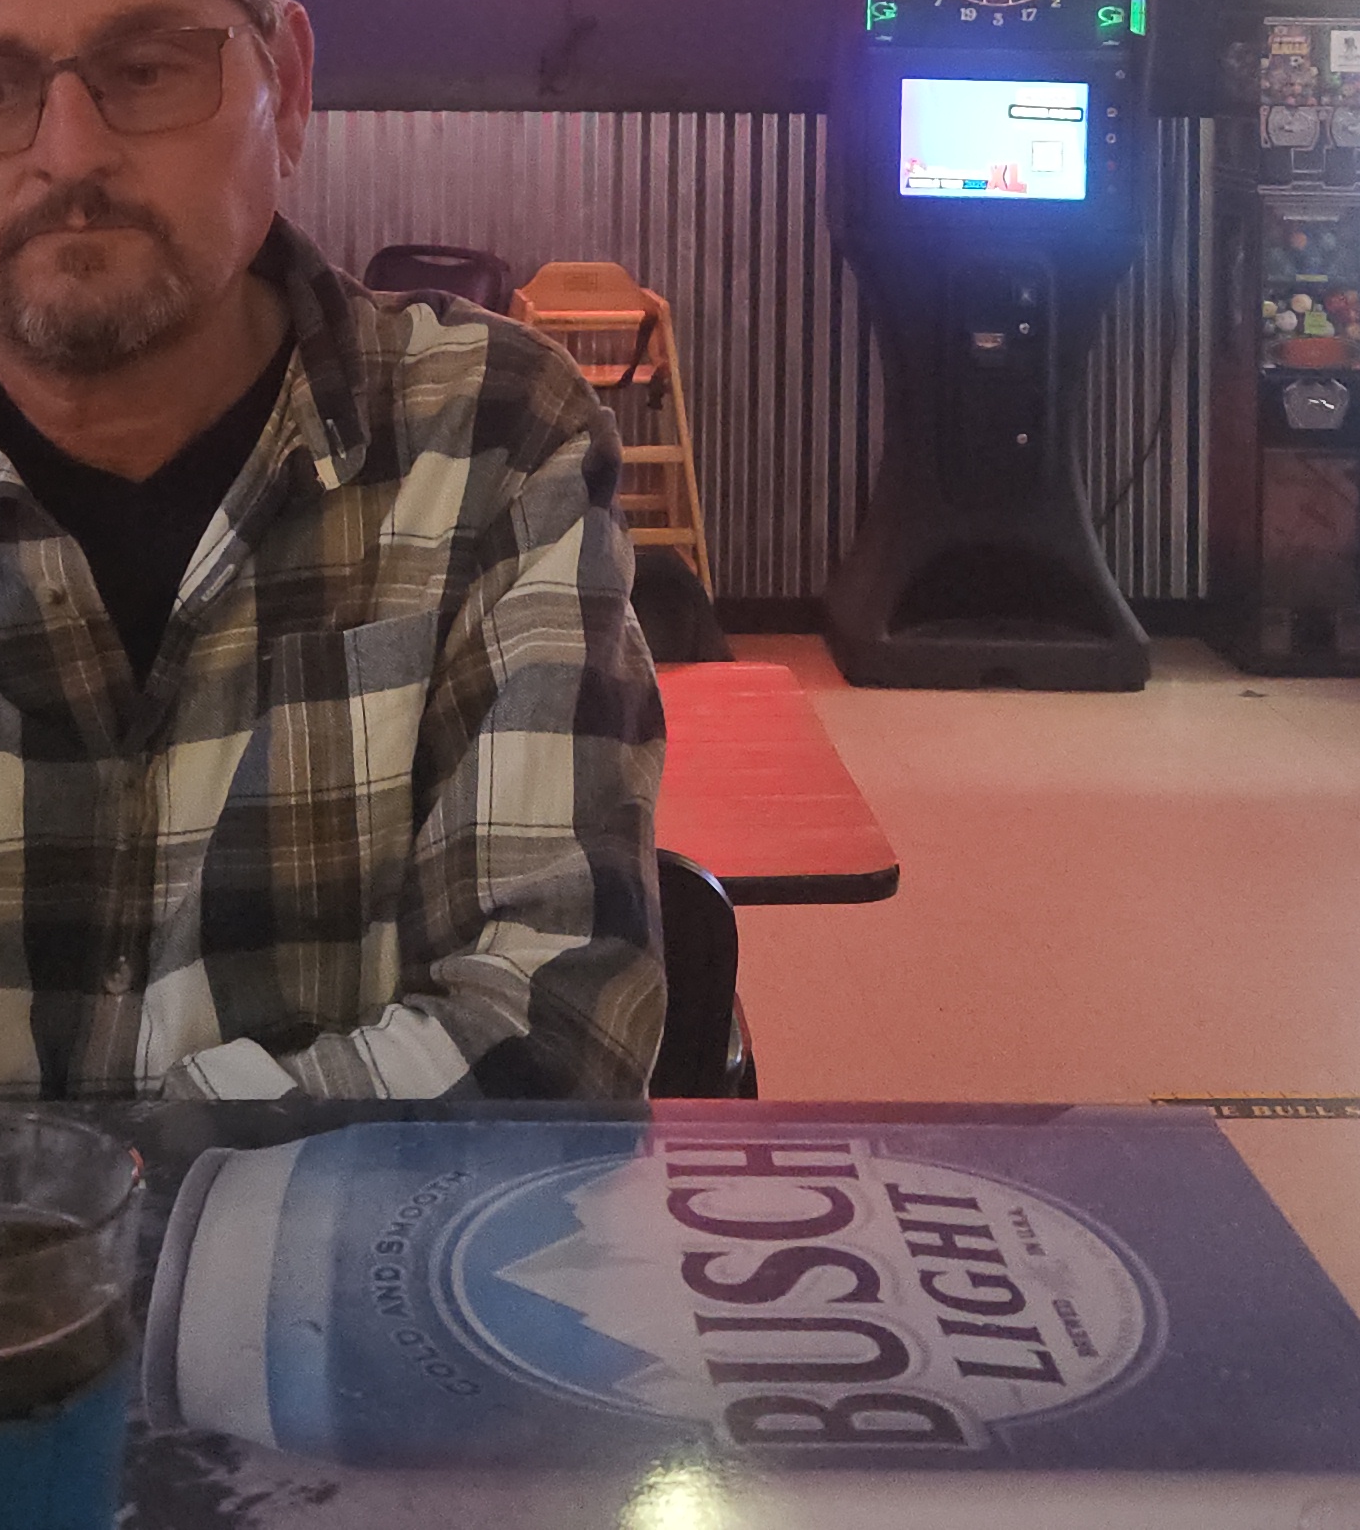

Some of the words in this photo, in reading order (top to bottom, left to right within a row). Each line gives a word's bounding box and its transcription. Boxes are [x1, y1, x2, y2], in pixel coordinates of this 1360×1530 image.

[960, 7, 977, 21] 19
[992, 12, 1004, 26] 3
[1020, 8, 1037, 22] 17
[1251, 1105, 1334, 1117] BULL
[375, 1170, 473, 1255] SMOOTH
[374, 1267, 409, 1318] AND
[665, 1142, 969, 1445] BUSCH
[884, 1182, 1067, 1387] LIGHT
[395, 1328, 482, 1396] COLD
